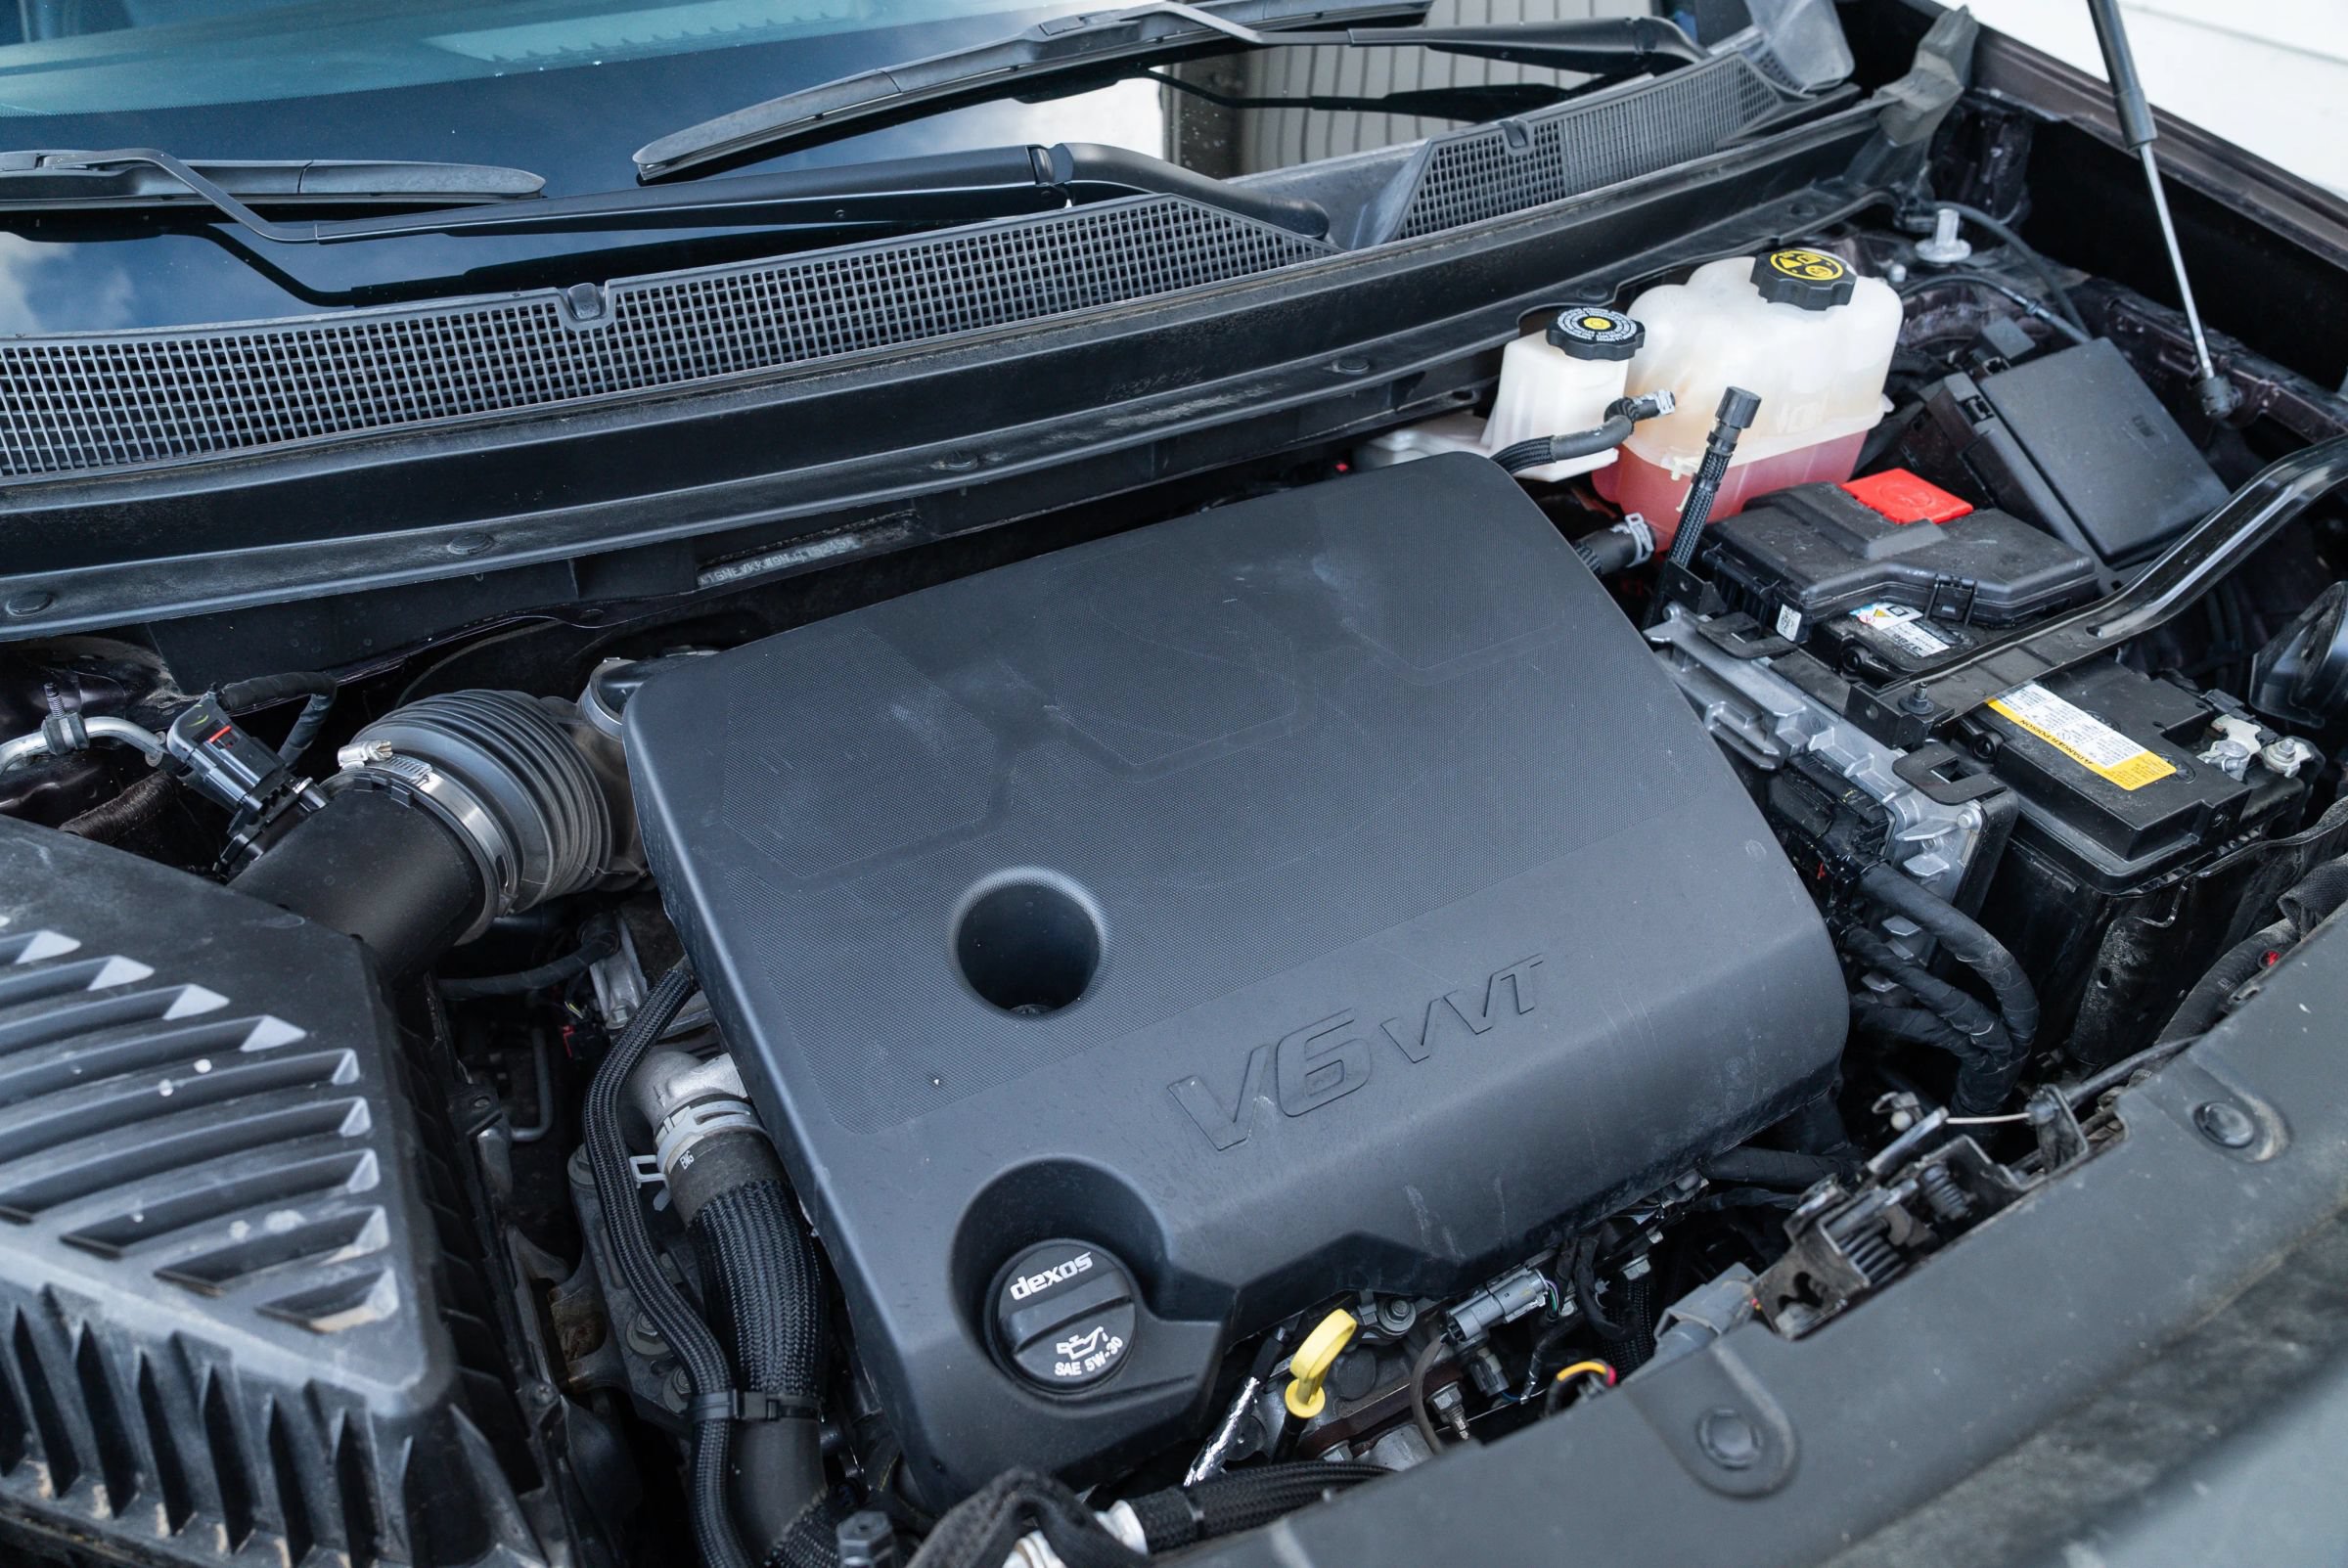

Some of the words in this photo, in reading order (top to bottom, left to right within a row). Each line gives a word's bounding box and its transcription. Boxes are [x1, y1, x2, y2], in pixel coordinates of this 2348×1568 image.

[1167, 1008, 1372, 1151] V6
[1379, 953, 1544, 1064] VVT
[679, 1149, 695, 1170] ENG
[1010, 1251, 1093, 1300] dexos
[1055, 1361, 1082, 1376] SAE
[1084, 1336, 1123, 1371] 5W-30
